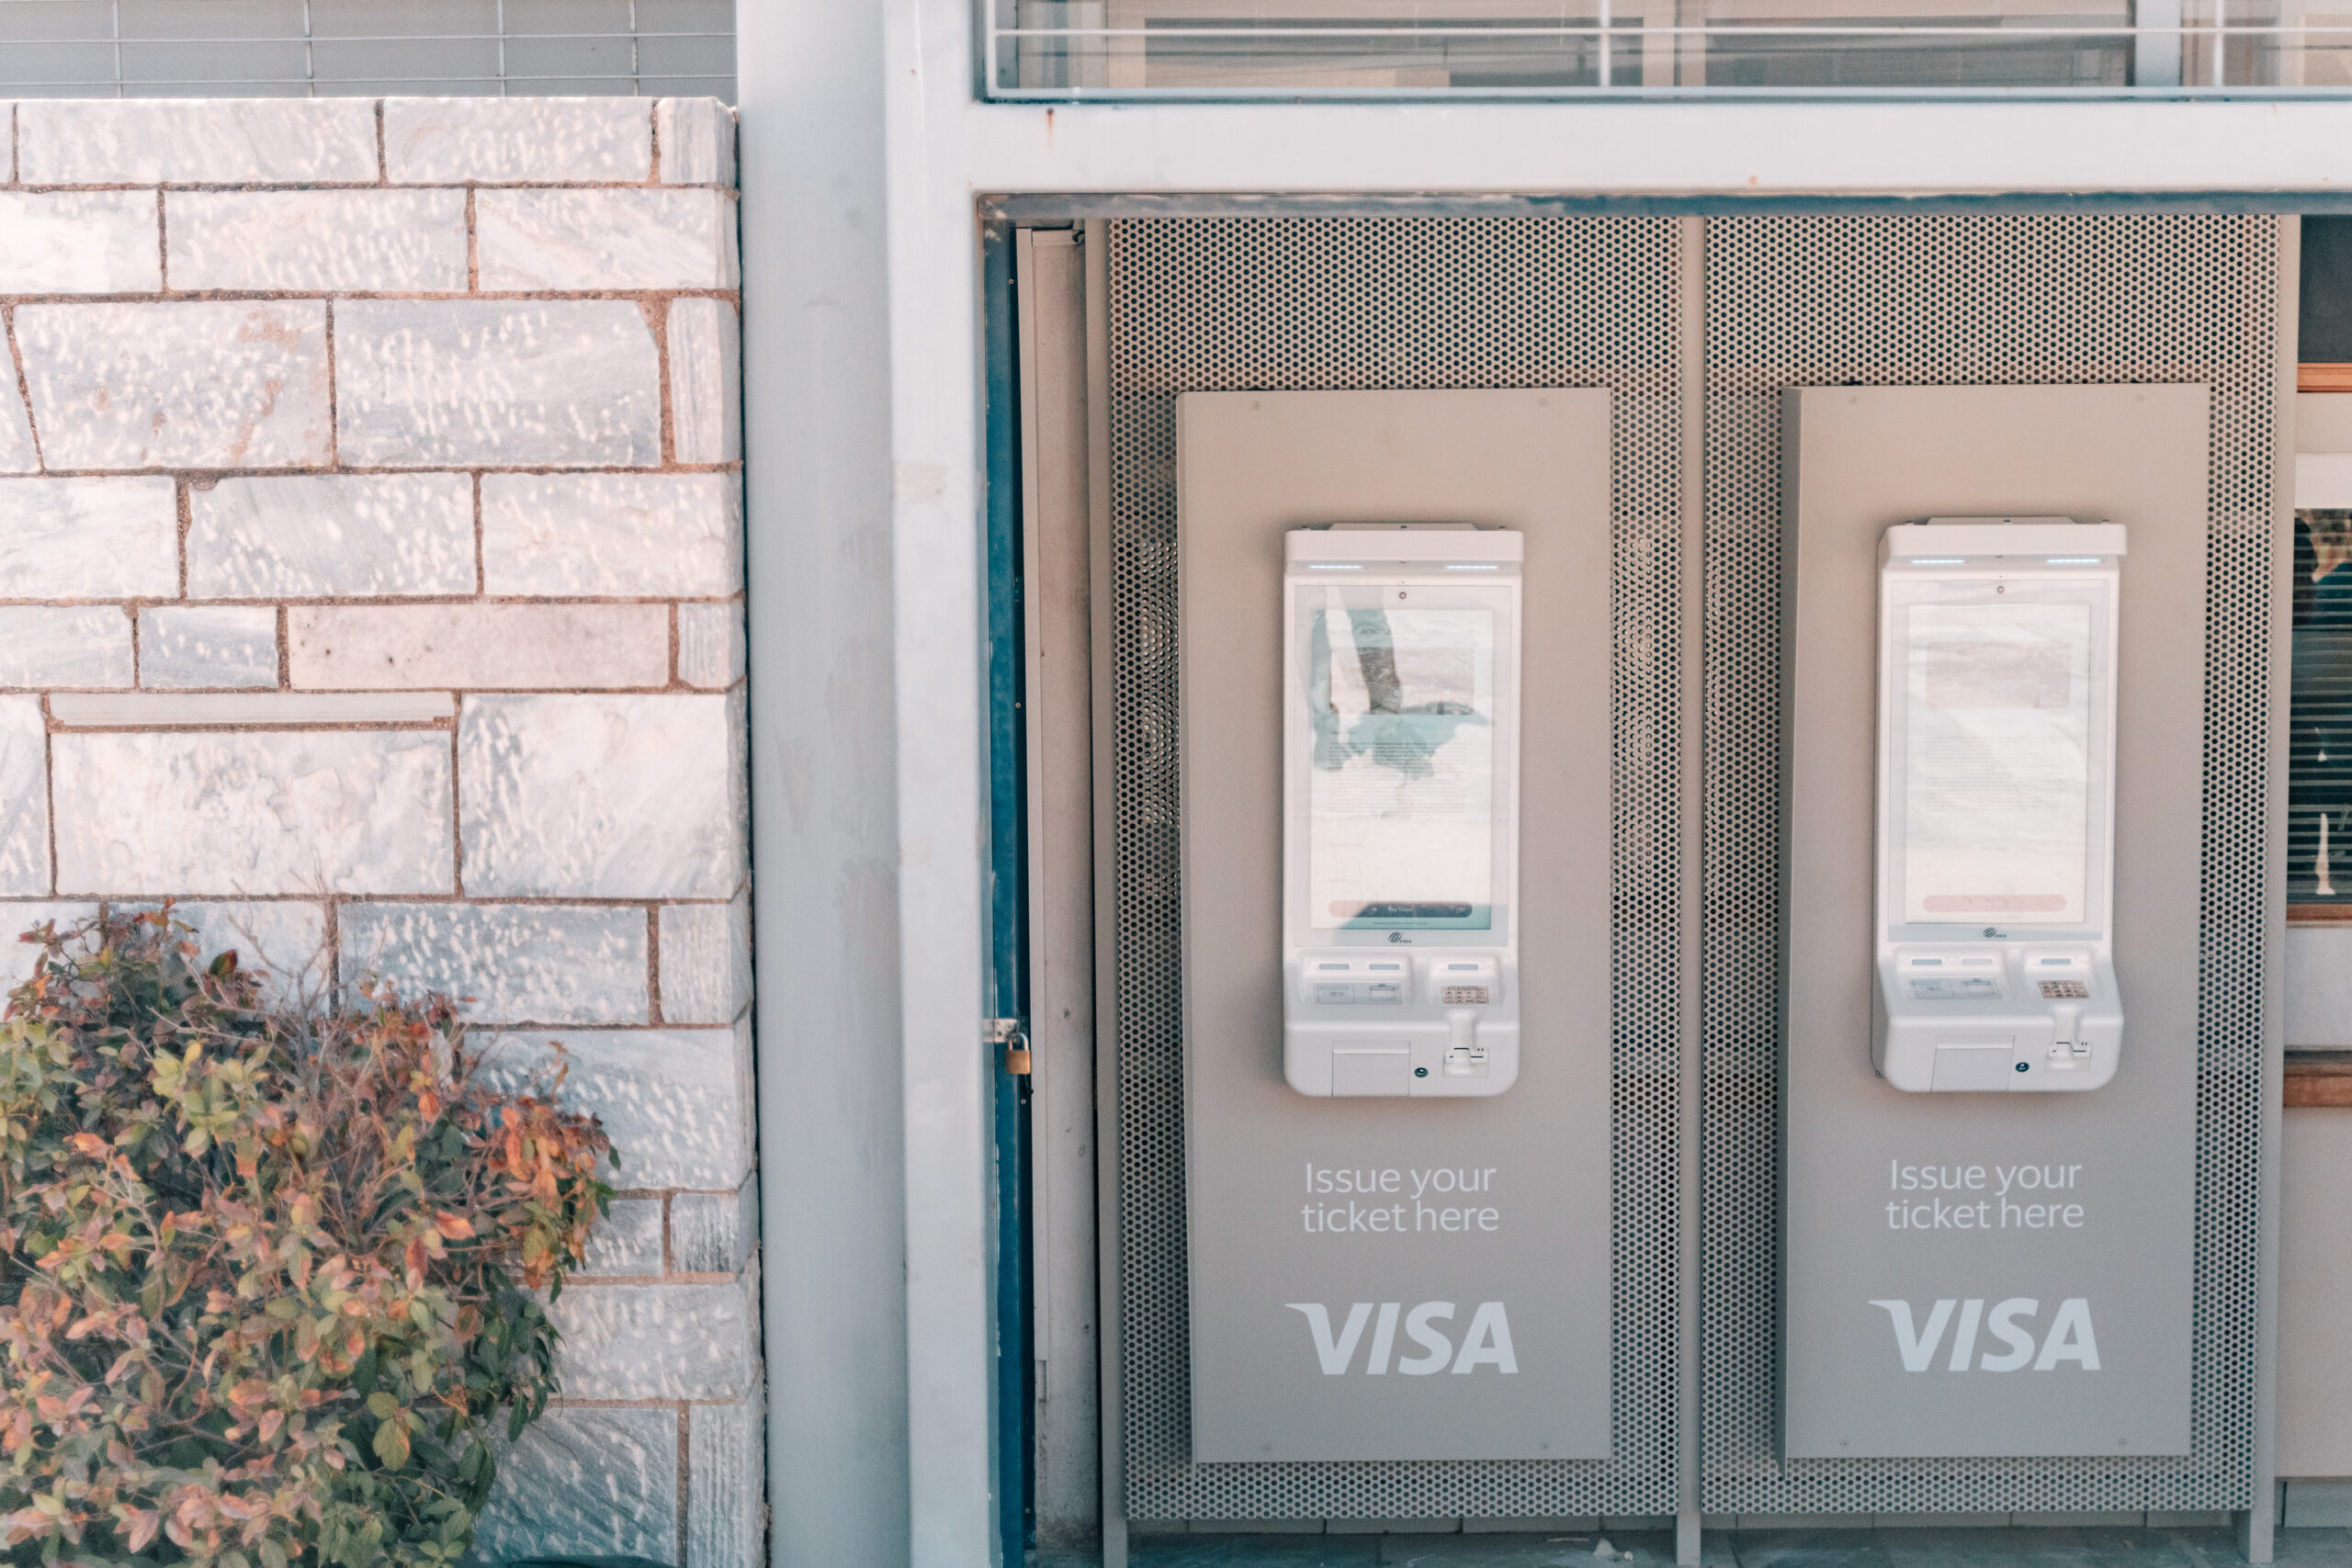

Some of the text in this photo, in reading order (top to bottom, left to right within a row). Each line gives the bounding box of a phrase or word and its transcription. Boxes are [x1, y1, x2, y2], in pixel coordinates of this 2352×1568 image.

[1306, 1162, 1497, 1200] Issue your
[1891, 1159, 2083, 1196] Issue your
[1300, 1200, 1500, 1233] ticket here
[1885, 1196, 2085, 1229] ticket here
[1284, 1301, 1519, 1376] VISA
[1868, 1297, 2101, 1372] VISA
